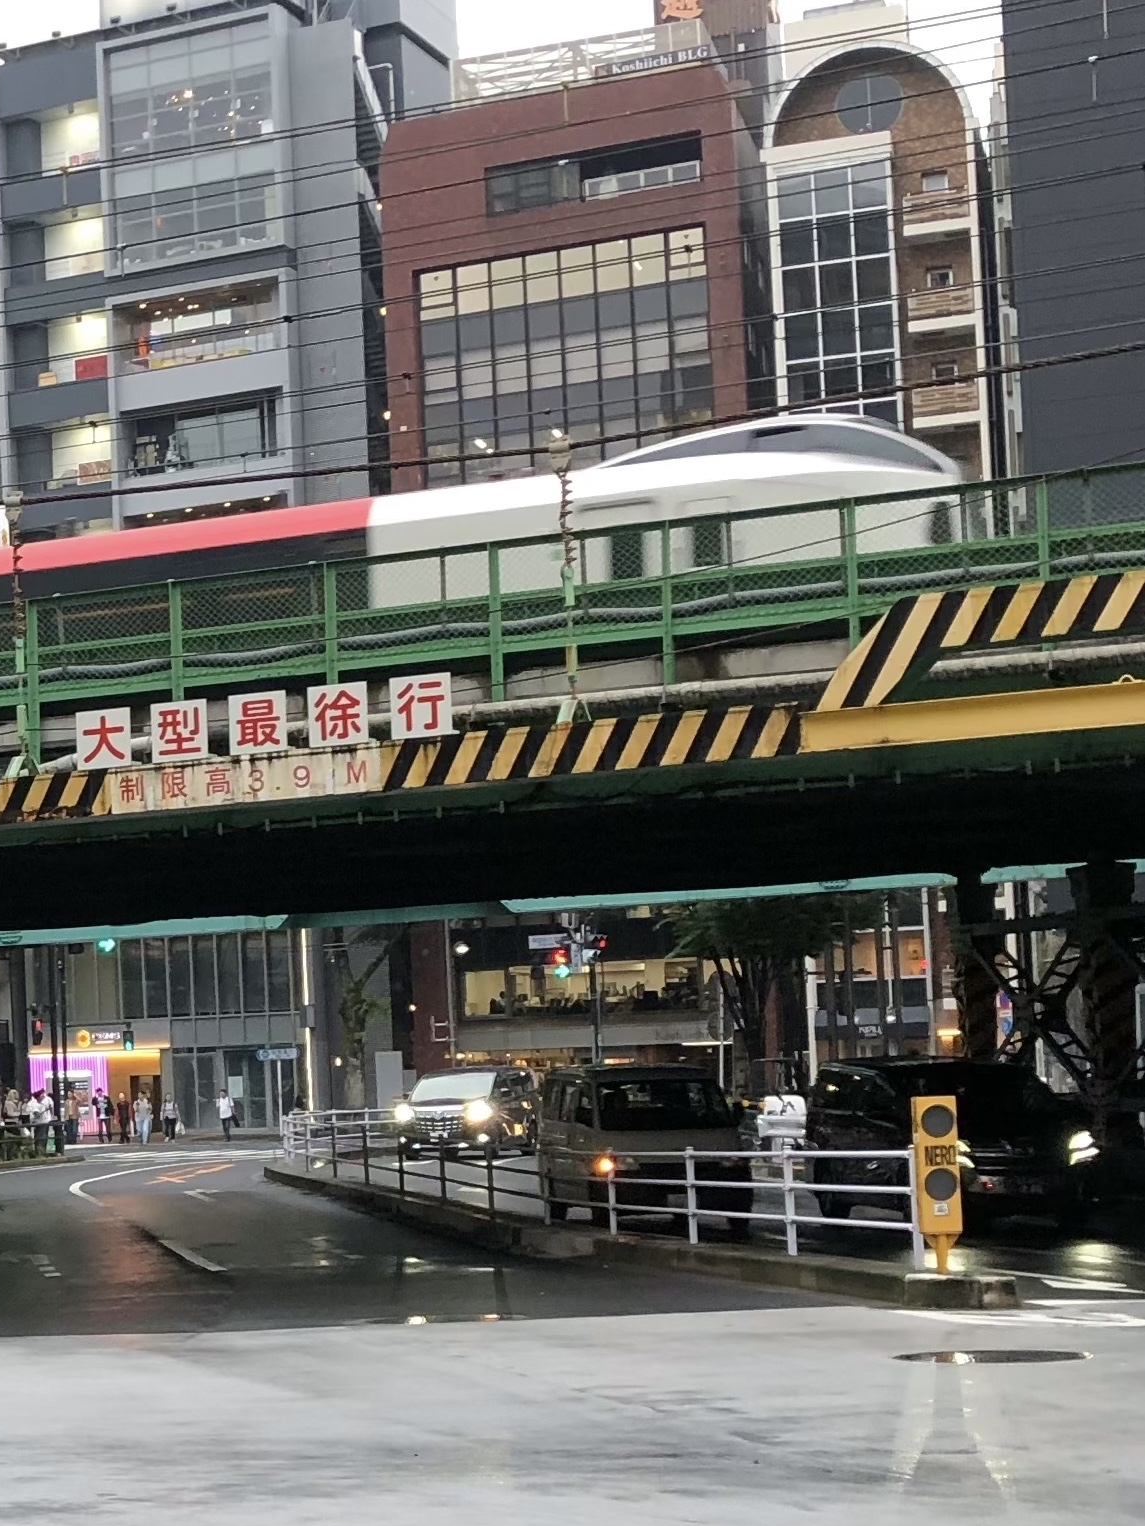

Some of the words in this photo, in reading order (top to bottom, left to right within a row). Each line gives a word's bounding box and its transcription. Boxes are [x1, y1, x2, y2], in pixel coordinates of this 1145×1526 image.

[677, 46, 708, 62] BLG
[81, 680, 443, 765] 大型最徐行
